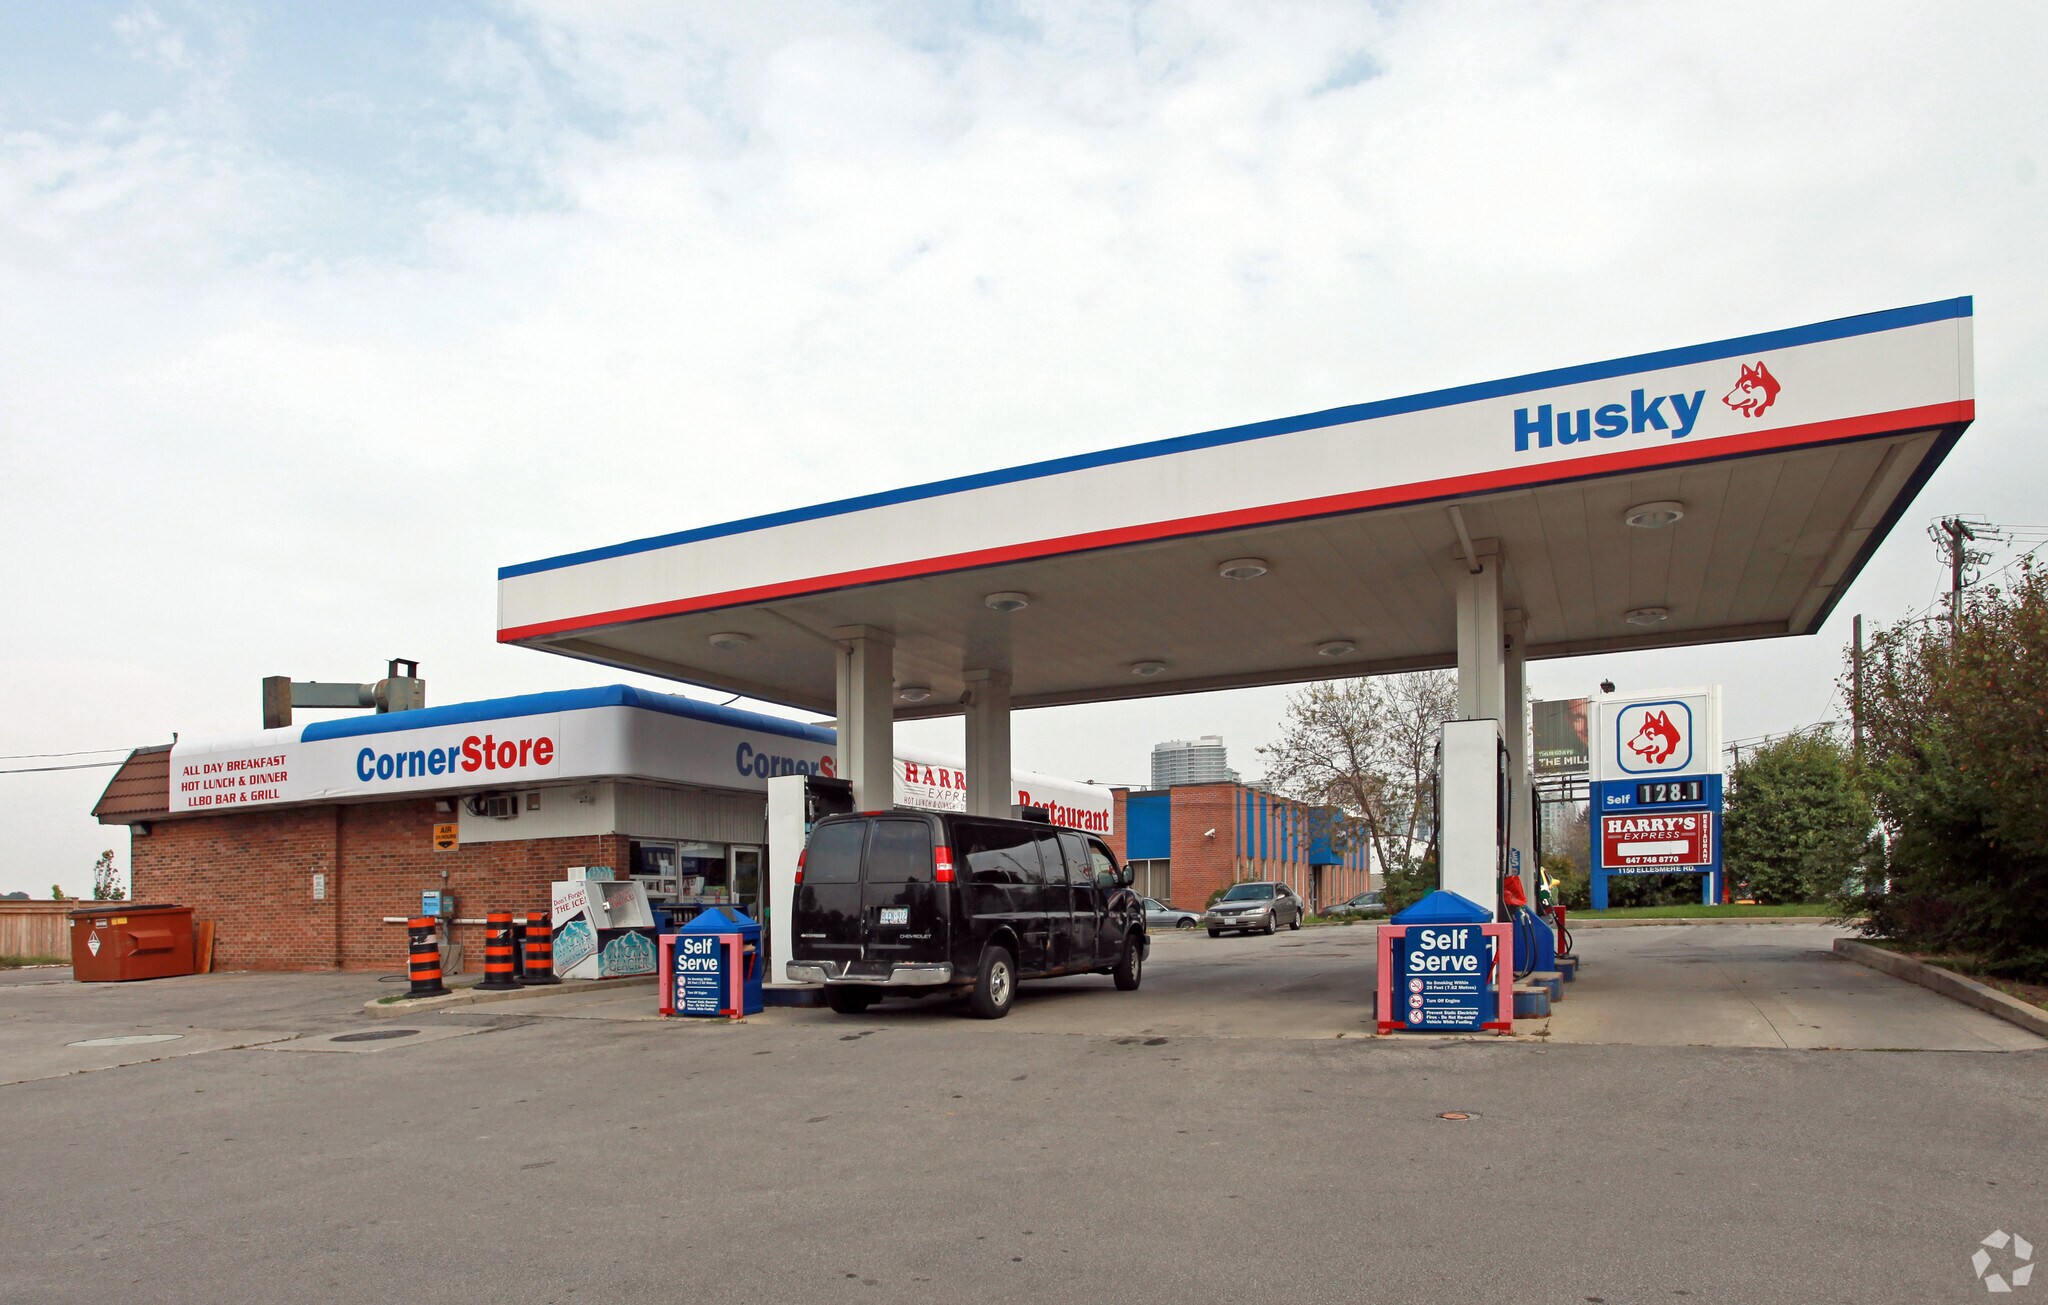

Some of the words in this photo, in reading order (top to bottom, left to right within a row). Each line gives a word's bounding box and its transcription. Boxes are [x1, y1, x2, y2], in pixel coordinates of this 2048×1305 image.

[1513, 388, 1706, 452] Husky
[183, 765, 200, 776] ALL
[204, 763, 224, 774] DAY
[227, 755, 286, 771] BREAKFAST
[357, 734, 554, 782] CornerStore
[736, 742, 837, 779] CornerS
[1539, 757, 1561, 766] THE
[181, 781, 200, 792] HOT
[204, 777, 235, 789] LUNCH
[238, 776, 246, 786] &
[249, 771, 288, 785] DINNER
[904, 761, 967, 790] HARR
[188, 795, 212, 807] LLBO
[215, 793, 236, 804] BAR
[239, 792, 247, 802] &
[251, 789, 280, 800] GRILL
[904, 796, 914, 805] HOT
[928, 788, 967, 802] EXPRE
[1606, 794, 1631, 805] Self
[1643, 782, 1698, 803] 128.1
[1607, 817, 1696, 833] HARRY'S
[1624, 831, 1680, 840] EXPRESS
[568, 889, 585, 899] Forget
[555, 902, 571, 914] THE
[572, 897, 587, 908] ICE!
[683, 938, 713, 954] Self
[1420, 928, 1468, 950] Self
[609, 957, 649, 971] GLACIER
[677, 954, 718, 971] Serve
[1409, 951, 1478, 972] Serve
